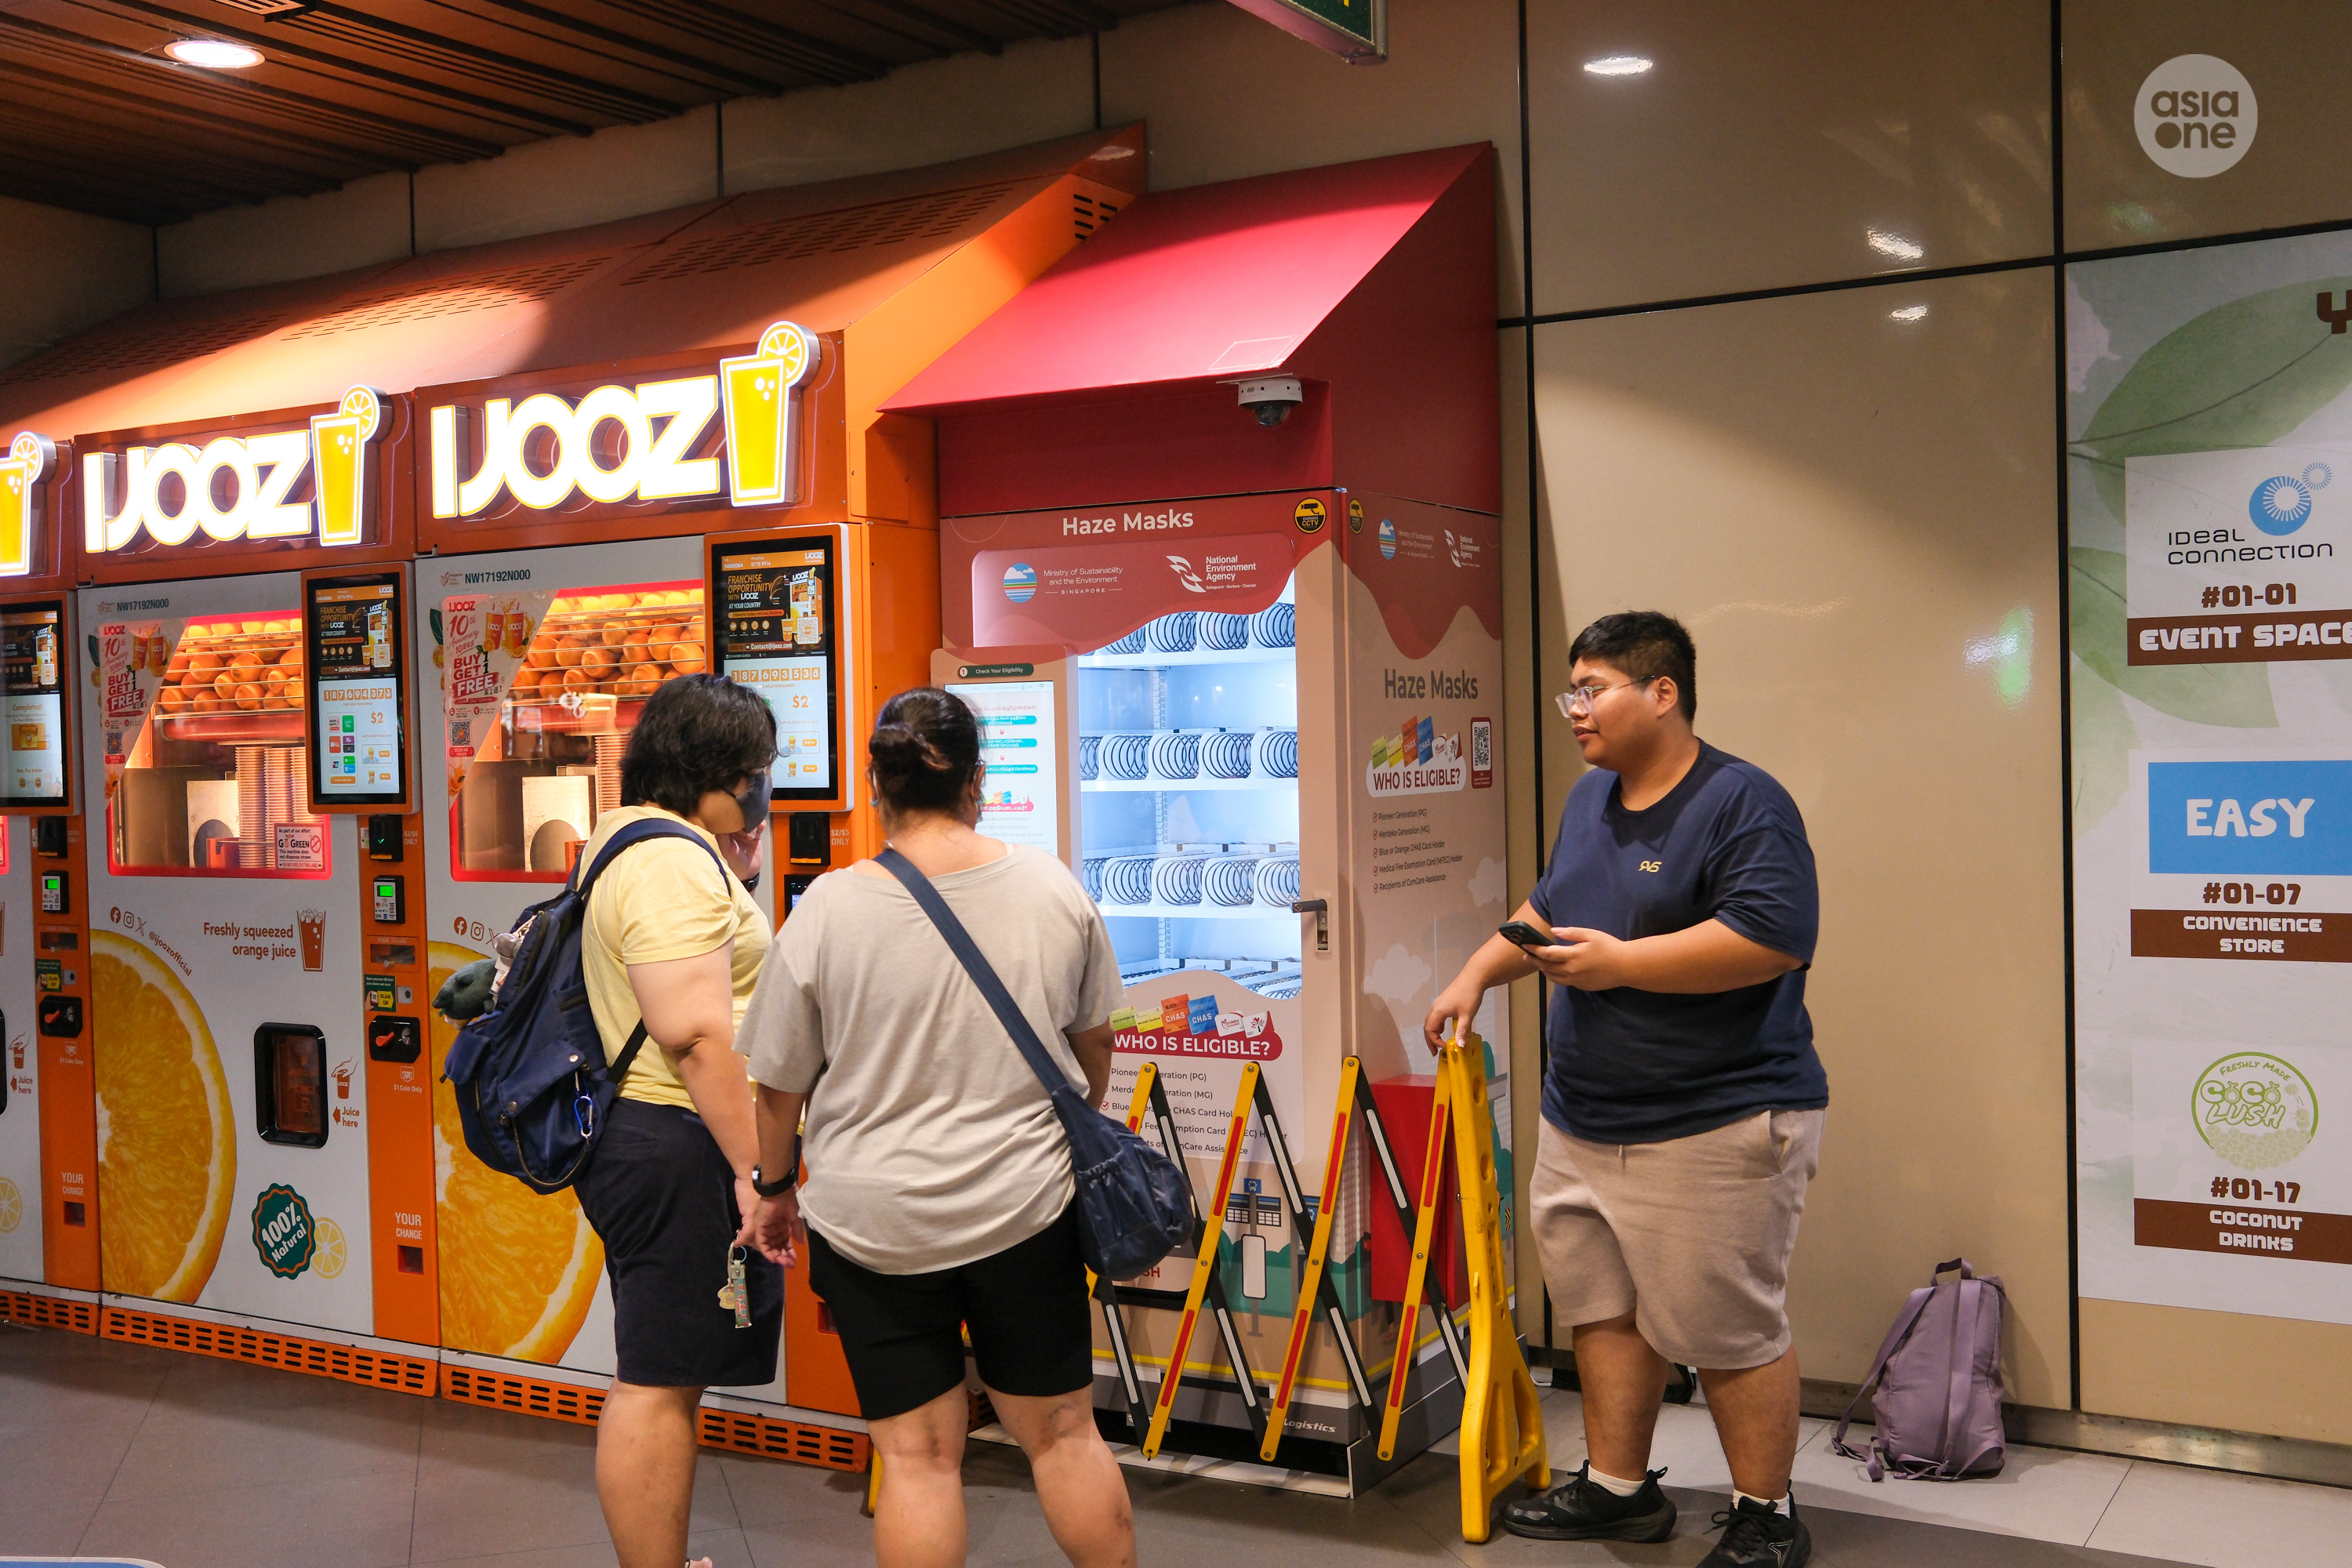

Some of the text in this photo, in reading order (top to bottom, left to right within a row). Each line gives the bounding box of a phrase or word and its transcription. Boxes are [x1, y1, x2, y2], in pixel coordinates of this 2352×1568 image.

[430, 374, 720, 519] IJOOZ
[83, 429, 311, 554] IJOOZ
[1062, 509, 1194, 536] Haze Masks
[1460, 535, 1472, 543] National
[1460, 543, 1480, 553] Environment
[1461, 550, 1472, 560] Agency
[1206, 555, 1238, 564] National
[1080, 567, 1123, 575] Sustainability
[1206, 562, 1257, 572] Environment
[465, 569, 531, 583] NW17192N000
[728, 573, 762, 585] FRANCHISE
[1076, 575, 1118, 584] Environment
[1206, 572, 1236, 583] Agency
[728, 583, 772, 593] OPPORTUNITY
[741, 592, 759, 601] IJOOZ
[2201, 583, 2296, 608] #01-01
[117, 598, 169, 612] NW17192N000
[448, 601, 476, 613] IJOOZ
[103, 625, 125, 635] IJOOZ
[2140, 626, 2241, 651] EVENT
[453, 650, 489, 670] BUY 1
[108, 670, 136, 686] BUY 1
[453, 662, 489, 681] GET 1
[108, 681, 136, 696] GET 1
[457, 674, 494, 697] FREE
[1385, 668, 1479, 699] Haze Masks
[111, 691, 141, 711] FREE
[793, 694, 809, 709] $2
[371, 711, 383, 724] $2
[1404, 739, 1417, 753] CHAS
[1419, 739, 1431, 753] CHAS
[1374, 771, 1400, 791] WHO
[1403, 771, 1411, 789] IS
[1414, 768, 1461, 788] ELIGIBLE?
[1396, 810, 1418, 819] Generation
[1418, 808, 1427, 818] (PG)
[2187, 798, 2315, 838] EASY
[1378, 829, 1397, 839] Merdeka
[1397, 826, 1420, 836] Generation
[291, 839, 310, 848] GREEN
[1379, 848, 1388, 856] Blue
[1395, 846, 1410, 855] Orange
[1410, 843, 1421, 851] CHAS
[1380, 863, 1396, 873] Medical
[1404, 859, 1426, 869] Exemption
[1427, 858, 1436, 866] Card
[1379, 881, 1401, 891] Recipients
[1406, 877, 1425, 886] ComCare
[1425, 873, 1446, 883] Assistance
[2202, 883, 2302, 905] #01-07
[203, 922, 293, 941] Freshly squeezed
[2183, 916, 2322, 933] CONVENIENCE
[232, 943, 296, 960] orange juice
[2220, 938, 2285, 953] STORE
[149, 931, 192, 977] @ijoozofficial
[1165, 1011, 1186, 1022] CHAS
[1192, 1013, 1212, 1024] CHAS
[1114, 1034, 1271, 1056] WHO IS ELIGIBLE?
[1111, 1068, 1207, 1081] Pionee (PG)
[2220, 1061, 2292, 1081] FRESHLY MADE
[18, 1076, 33, 1085] Juice
[18, 1086, 32, 1094] here
[1194, 1090, 1214, 1099] (MG)
[342, 1106, 360, 1117] Juice
[1112, 1102, 1130, 1111] Blue
[1173, 1106, 1196, 1116] CHAS
[1198, 1108, 1217, 1117] Card
[2205, 1102, 2286, 1129] LUSH
[342, 1119, 358, 1127] here
[1207, 1127, 1226, 1135] Card
[61, 1172, 84, 1184] YOUR
[62, 1185, 84, 1196] CHANGE
[2210, 1176, 2301, 1203] #01-17
[262, 1202, 302, 1248] 100%
[394, 1212, 422, 1226] YOUR
[2209, 1210, 2303, 1230] COCONUT
[395, 1228, 423, 1240] CHANGE
[271, 1223, 307, 1263] Natural
[2219, 1232, 2294, 1251] DRINKS
